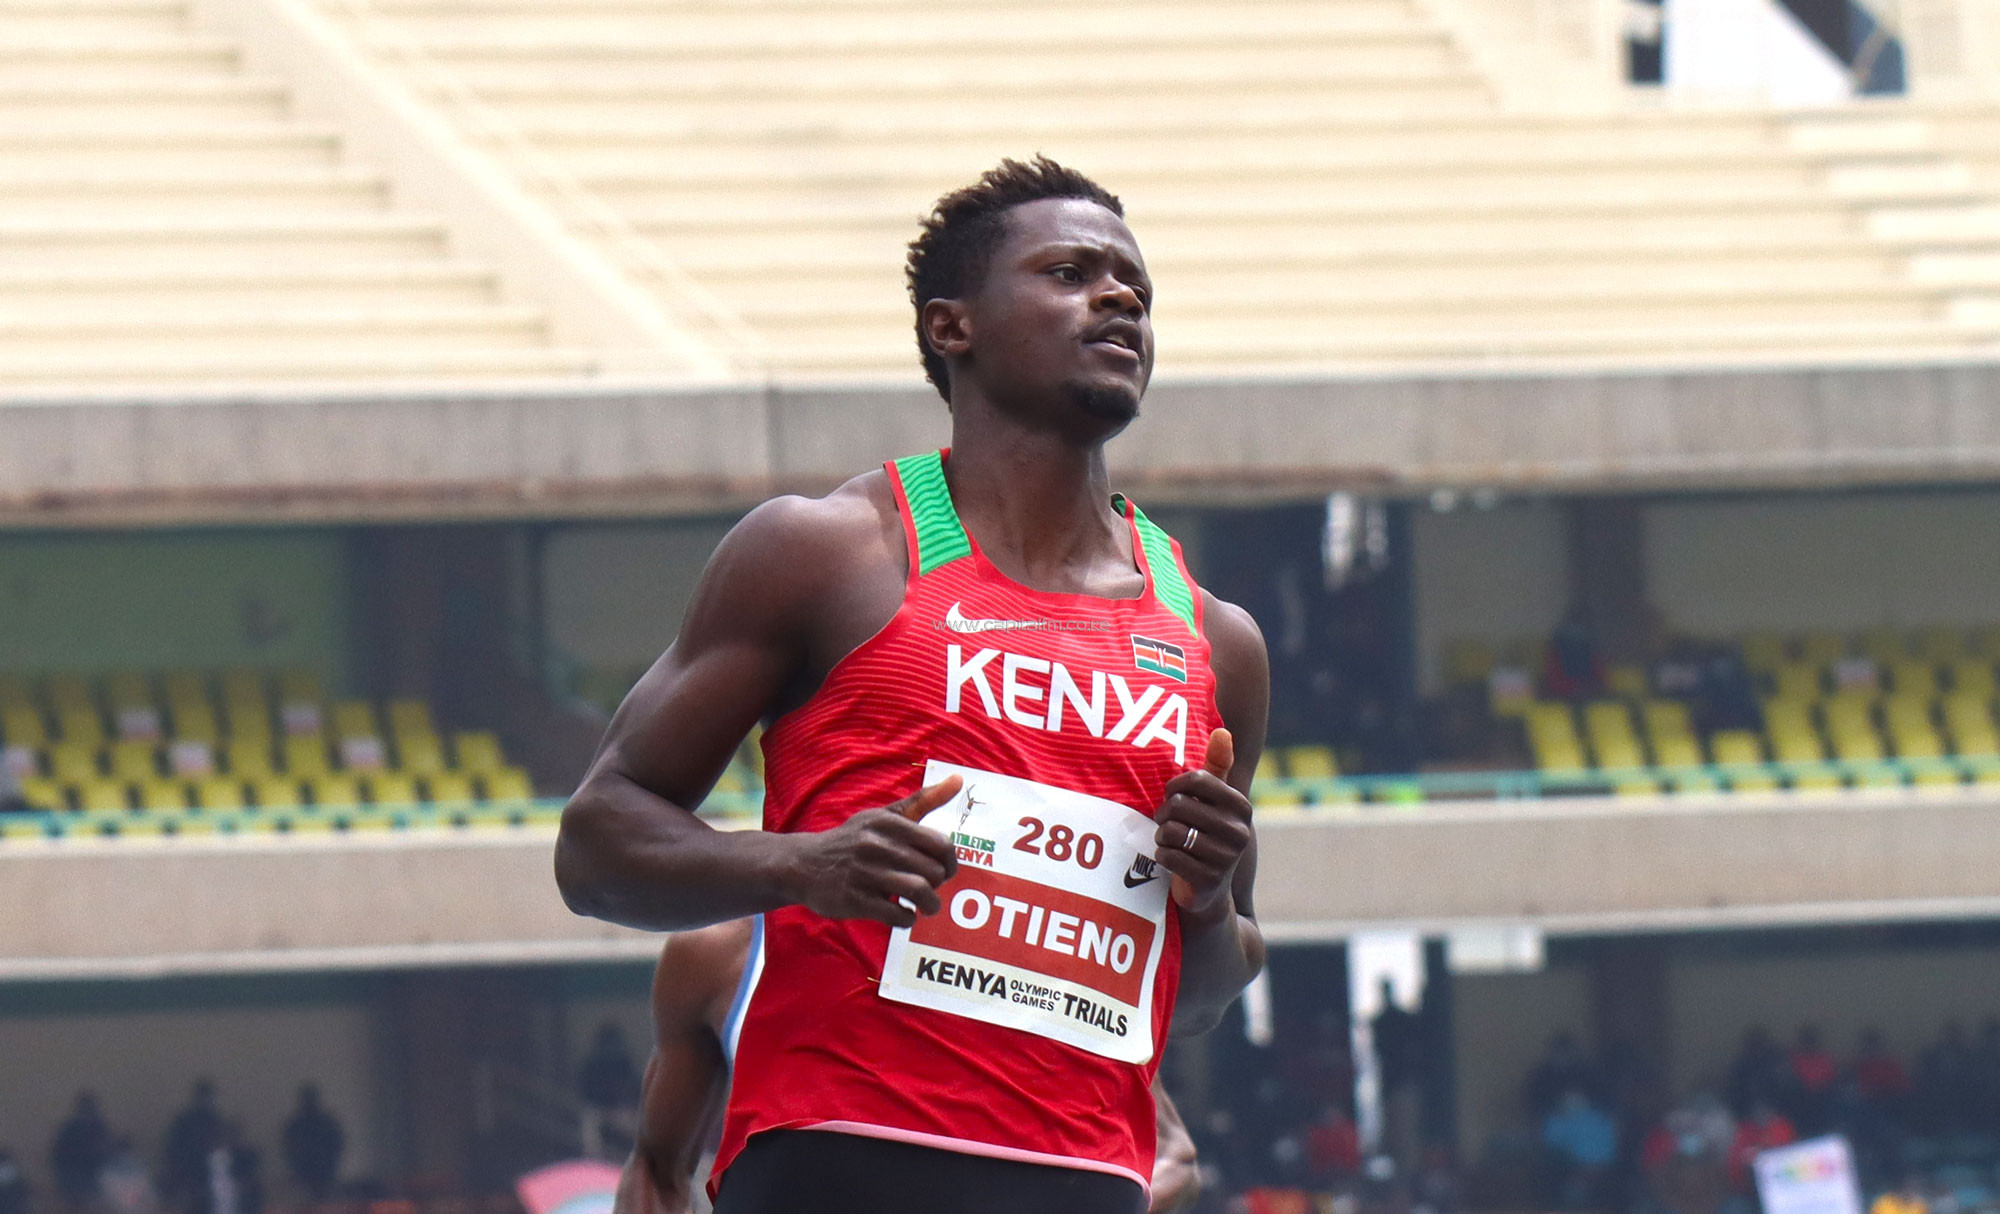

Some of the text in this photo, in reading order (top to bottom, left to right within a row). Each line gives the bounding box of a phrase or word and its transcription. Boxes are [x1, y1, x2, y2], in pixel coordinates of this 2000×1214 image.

[945, 644, 1188, 767] KENYA
[956, 846, 994, 868] ENYA
[1012, 816, 1104, 870] 280
[950, 888, 1136, 975] OTIENO
[916, 957, 1128, 1038] KENYA OLYMPIC GAMES TRIALS
